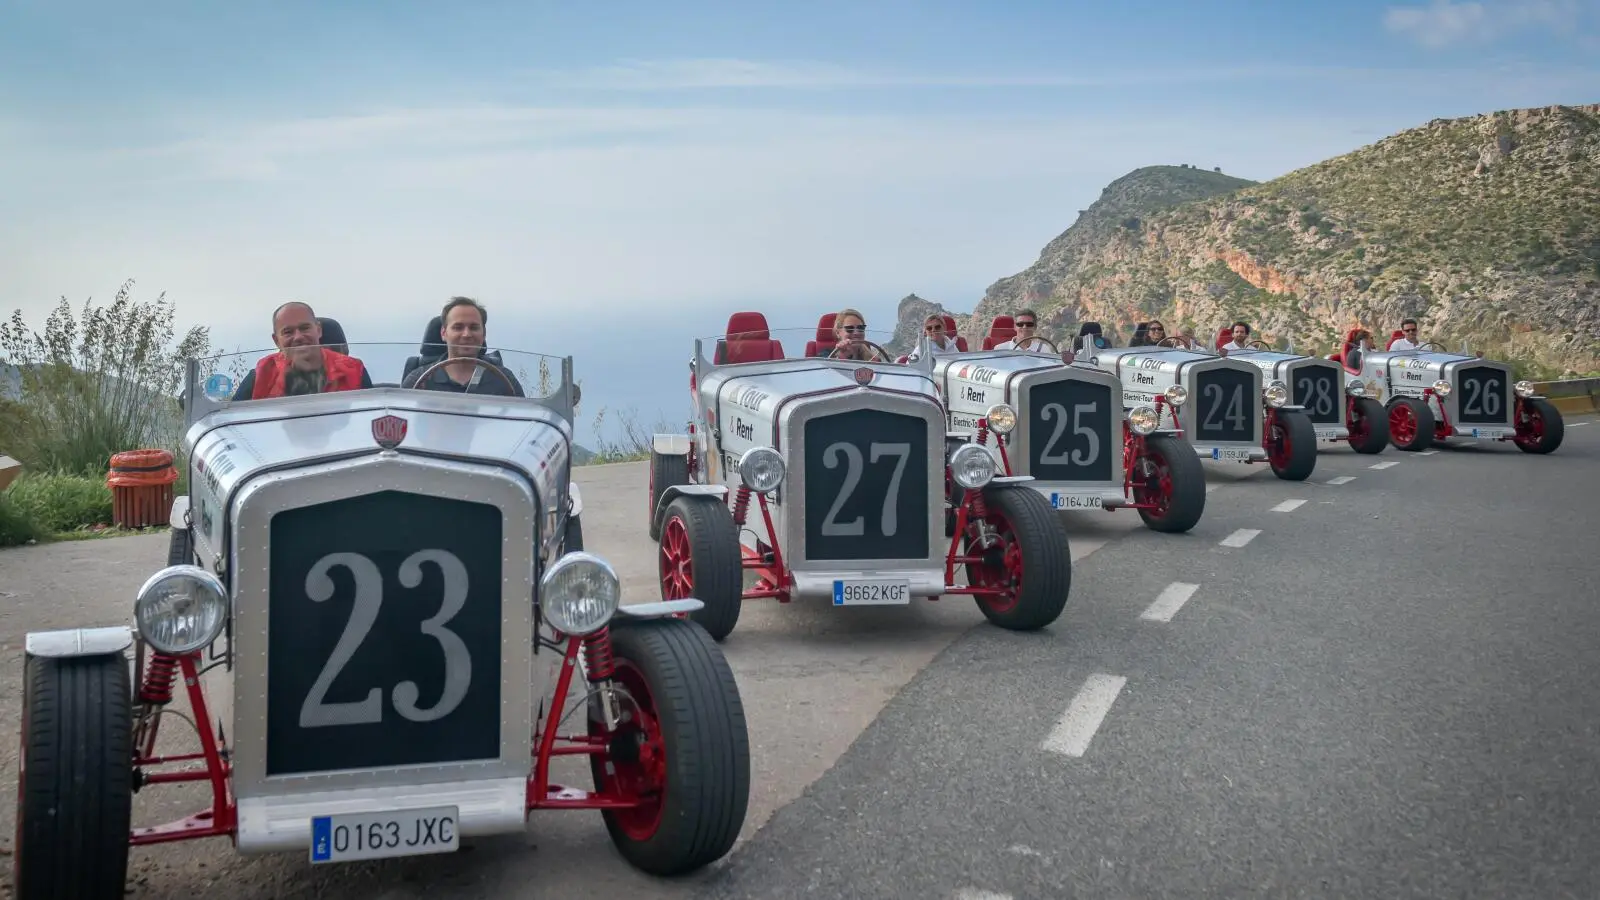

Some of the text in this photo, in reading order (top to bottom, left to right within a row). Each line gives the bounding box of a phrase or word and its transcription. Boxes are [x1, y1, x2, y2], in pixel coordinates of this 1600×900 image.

[1141, 358, 1166, 370] Tour
[1409, 359, 1430, 369] Tour
[971, 365, 998, 383] Tour
[1137, 373, 1154, 385] Rent
[1407, 372, 1422, 381] Rent
[967, 387, 985, 403] Rent
[1298, 377, 1333, 416] 28
[1464, 378, 1500, 416] 26
[1202, 383, 1247, 431] 24
[736, 417, 753, 441] Rent
[953, 417, 978, 429] Electric-To
[1039, 401, 1100, 466] 25
[821, 442, 911, 536] 27
[1058, 496, 1101, 507] 0164 JXC
[844, 585, 879, 600] 9662
[881, 584, 907, 600] KGF
[299, 549, 471, 727] 23
[334, 821, 400, 852] 0163
[406, 817, 453, 847] JXC
